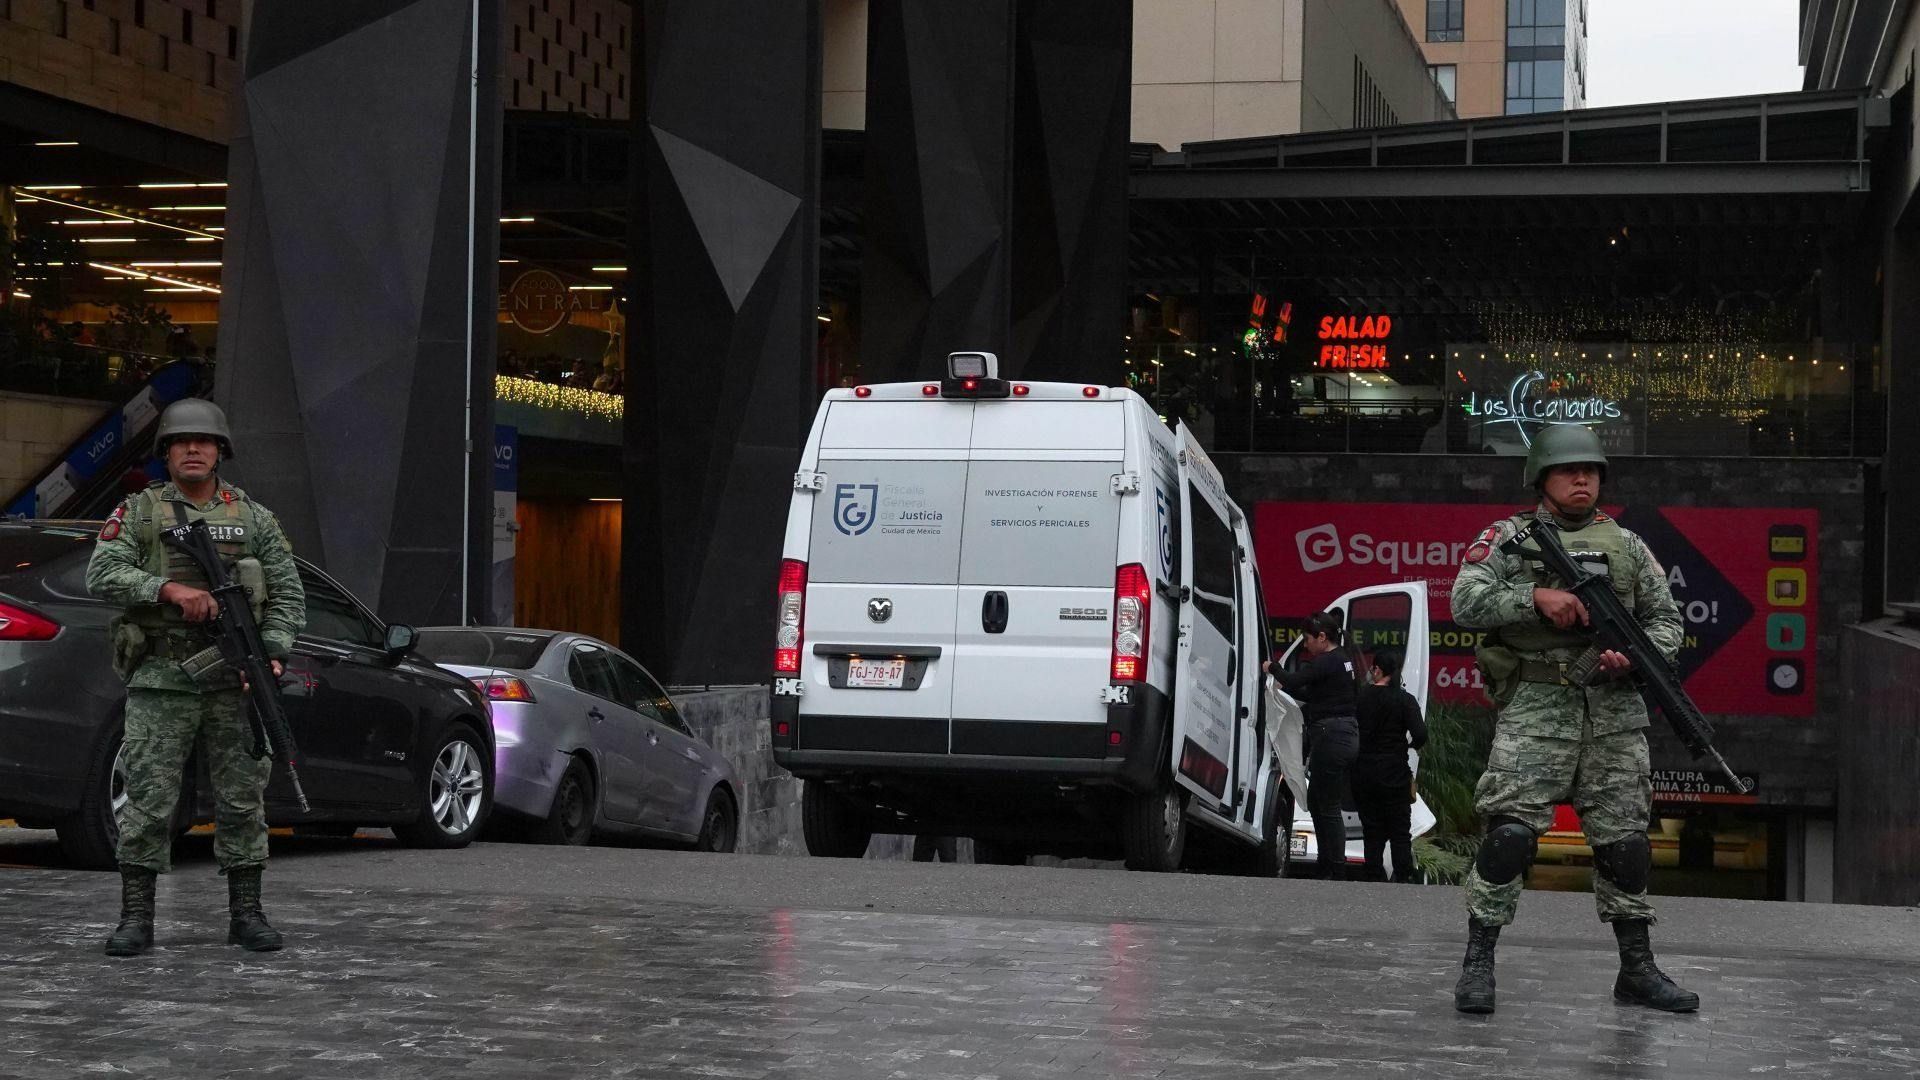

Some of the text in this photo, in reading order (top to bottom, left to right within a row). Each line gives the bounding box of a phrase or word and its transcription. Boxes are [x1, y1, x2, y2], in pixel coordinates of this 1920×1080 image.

[498, 294, 600, 310] ENTRAL
[1318, 315, 1391, 339] SALAD
[1470, 391, 1508, 416] Los
[985, 488, 1098, 498] INVESTIGACIÓN FORENSE
[899, 510, 943, 521] Justicia
[990, 519, 1090, 528] SERVICIOS PERICIALES
[881, 527, 904, 535] Ciudad
[906, 527, 915, 535] de
[1348, 533, 1466, 575] Squar
[1059, 607, 1107, 615] 2500
[850, 666, 902, 679] FGJ-78-A7
[1652, 771, 1705, 781] ALTURA
[1684, 782, 1710, 793] 2.10
